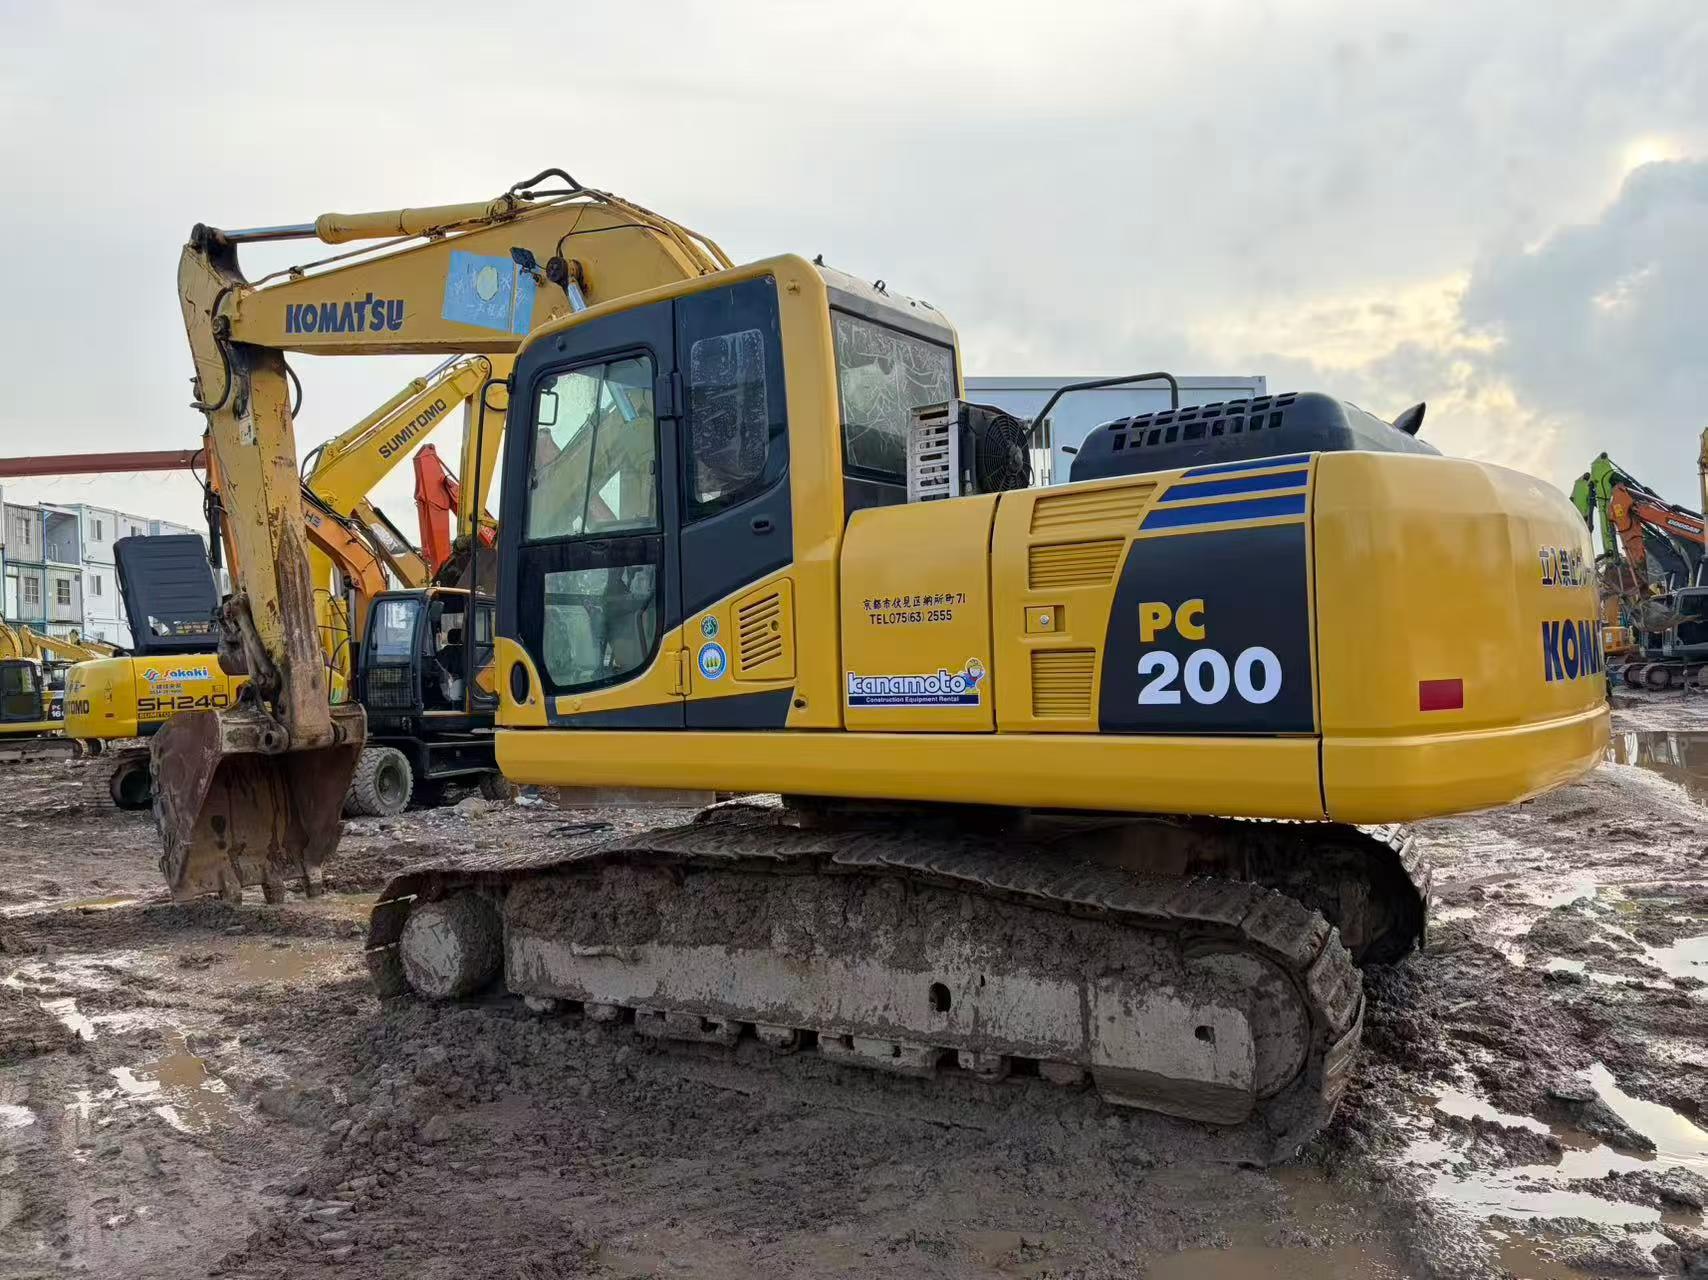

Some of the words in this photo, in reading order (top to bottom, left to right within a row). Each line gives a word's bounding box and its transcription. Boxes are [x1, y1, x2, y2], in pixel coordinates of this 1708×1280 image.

[285, 292, 404, 334] KOMATSU
[379, 399, 447, 459] SUMITOMO
[927, 609, 953, 622] 2555
[1138, 598, 1206, 643] PC
[847, 670, 968, 694] kanamoto
[1137, 646, 1283, 705] 200
[138, 694, 229, 712] SH240
[905, 695, 938, 704] Equipment
[939, 695, 960, 703] Rental
